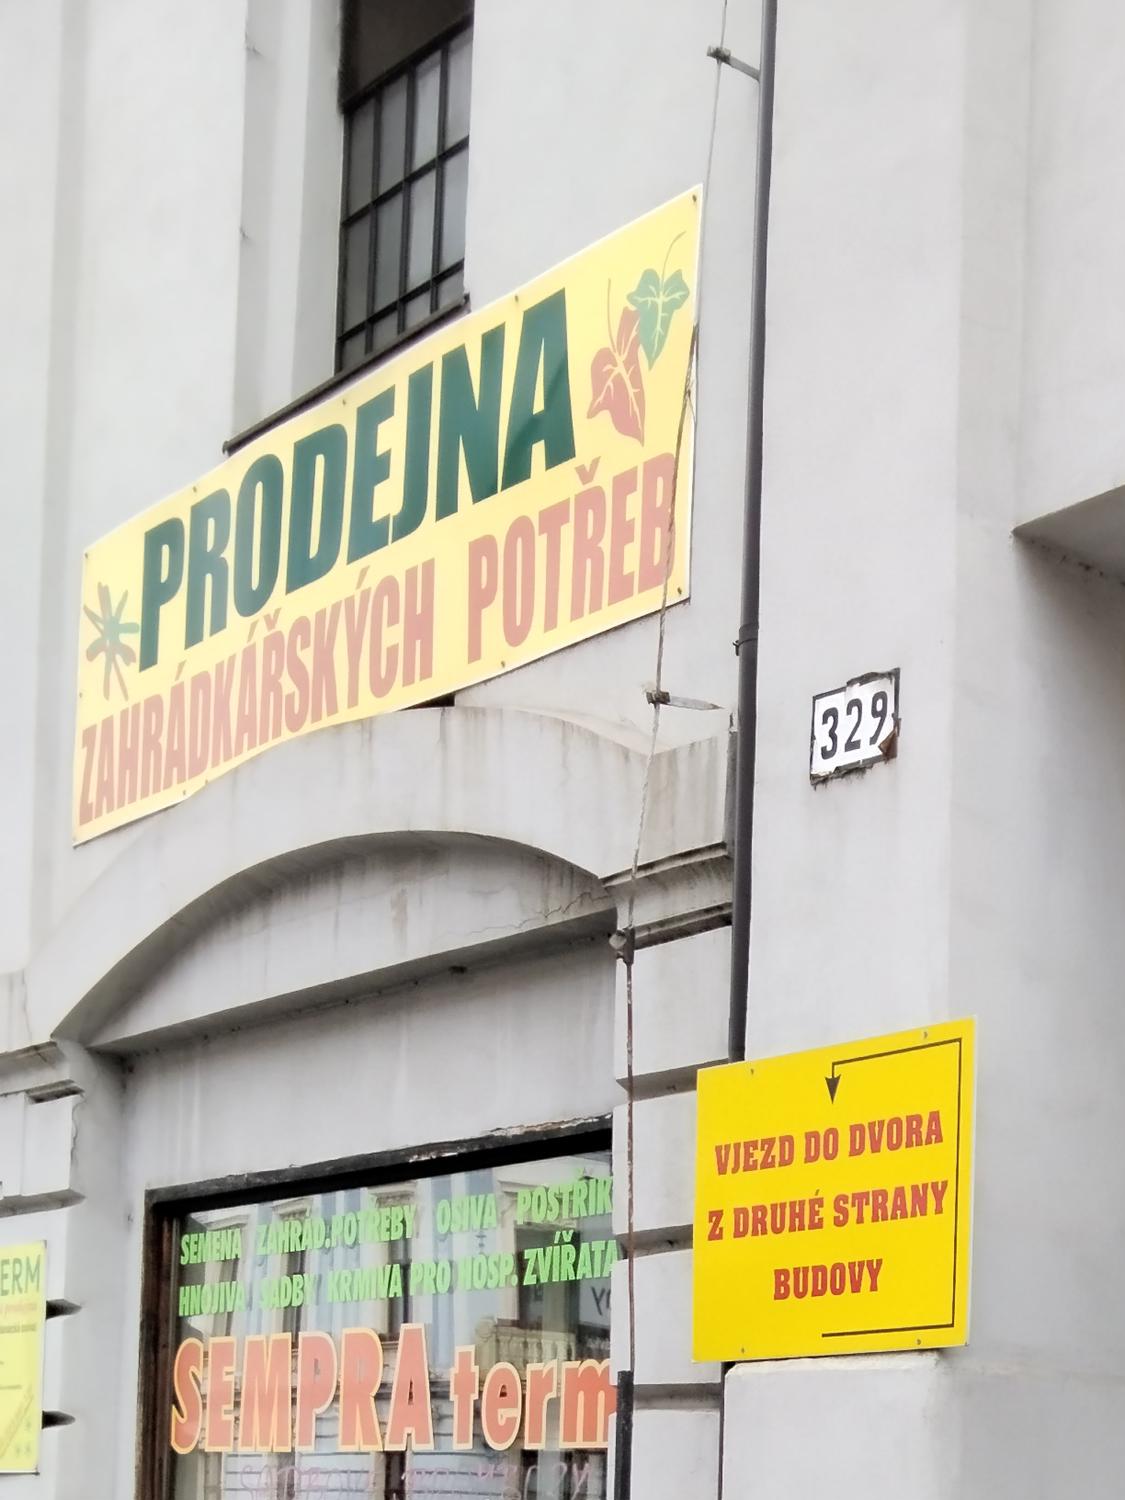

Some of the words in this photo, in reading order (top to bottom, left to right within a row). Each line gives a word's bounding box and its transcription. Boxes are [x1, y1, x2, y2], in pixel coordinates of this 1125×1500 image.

[139, 287, 575, 672] PRODEJNA
[79, 556, 435, 826] ZAHRÁDKÁŘSKÝCH
[467, 452, 677, 664] POTŘEB
[821, 691, 888, 760] 329
[714, 1135, 795, 1176] VJEZD
[804, 1127, 839, 1164] DO
[848, 1110, 943, 1157] DVORA
[180, 1228, 241, 1265] SEMENA
[436, 1194, 497, 1234] OSIVA
[707, 1209, 724, 1241] Z
[733, 1189, 824, 1238] DRUHÉ
[833, 1180, 948, 1227] STRANY
[179, 1281, 245, 1317] HNOJIVA
[260, 1274, 318, 1309] SADBY
[328, 1264, 402, 1302] KRMIVA
[409, 1259, 450, 1296] PRO
[458, 1253, 518, 1290] HOSP.
[523, 1230, 618, 1285] ZVÍŘATA
[774, 1258, 882, 1300] BUDOVY
[171, 1323, 434, 1454] SEMPRA
[450, 1345, 617, 1450] term
